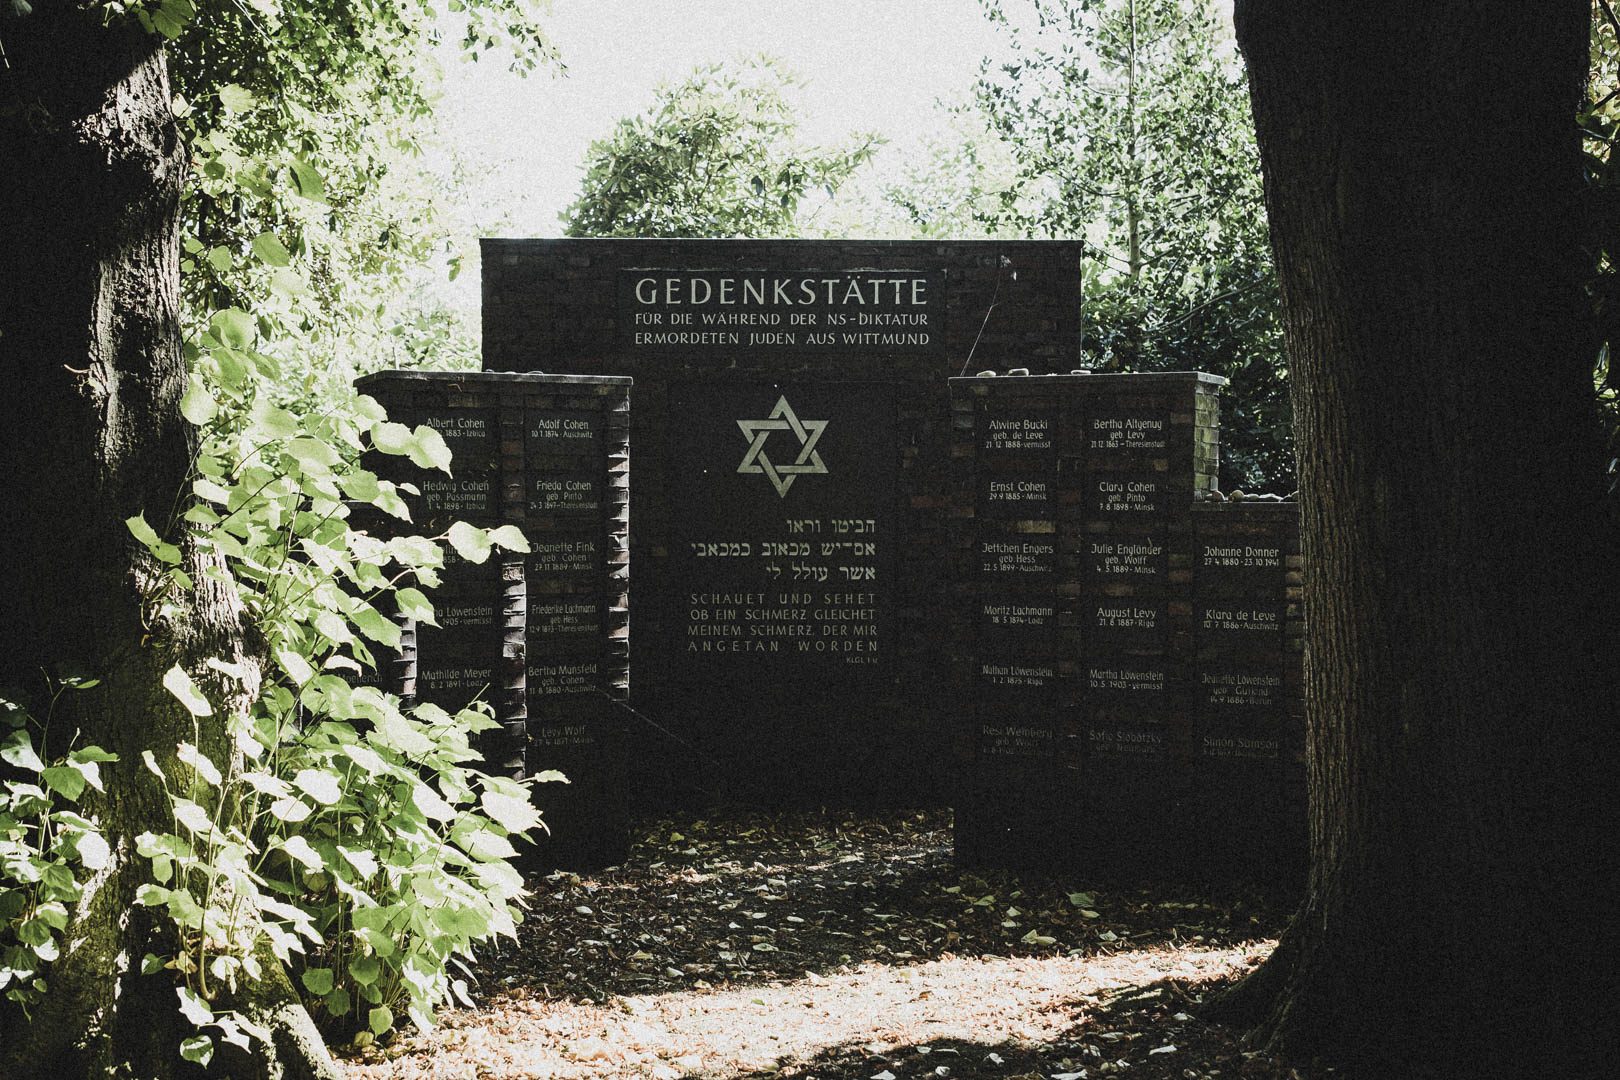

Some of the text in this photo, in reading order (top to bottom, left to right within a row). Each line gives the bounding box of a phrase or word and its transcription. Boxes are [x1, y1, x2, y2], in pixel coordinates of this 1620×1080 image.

[635, 275, 928, 305] GEDENKSTÄTTE
[635, 312, 928, 325] FÜR DIE WÄHREND DER NS-DIKTATUR
[635, 332, 930, 345] ERMORDETEN JUDEN AUS WITTMUND
[426, 418, 485, 428] Albert Cohen
[538, 419, 589, 430] Adolf Cohen
[989, 420, 1048, 430] Alwine Bucki
[1094, 419, 1123, 430] Bertha
[1025, 432, 1044, 440] Leve
[1127, 432, 1146, 440] Levy
[423, 480, 490, 492] Hedwig Cohen
[536, 480, 592, 490] Frieda Cohen
[990, 482, 1046, 492] Ernst Cohen
[1100, 482, 1156, 492] Clara Cohen
[1126, 494, 1146, 502] Pinto
[786, 519, 876, 533] הביטו וראו
[533, 542, 595, 552] Jeanette Fink
[761, 542, 811, 557] מכאוב
[982, 543, 1054, 556] Jettchen Engers
[1091, 544, 1113, 554] Julie
[1204, 546, 1280, 557] Johanne Donner
[562, 554, 587, 562] Cohen
[1016, 555, 1036, 564] Hess
[1124, 556, 1148, 565] Wolff
[766, 561, 876, 582] אשר עולל לי
[690, 594, 875, 604] SCHAUET UND SEHET
[531, 604, 596, 614] Friederike Lachmann
[690, 609, 876, 620] OB EIN SCHMERZ GLEICHET
[984, 606, 1052, 616] Moritz Lachmann
[1096, 607, 1156, 620] August Levy
[1206, 610, 1276, 620] Klara de Leve
[688, 624, 742, 636] MEINEM
[823, 624, 848, 636] DER
[853, 624, 877, 636] MIR
[688, 640, 877, 652] ANGETAN WORDEN
[421, 668, 492, 680] Mathilde Meyer
[528, 664, 597, 677] Bertha Mansfeld
[982, 664, 1008, 675] Nathan
[1090, 669, 1118, 680] Martha
[560, 676, 584, 684] Cohen
